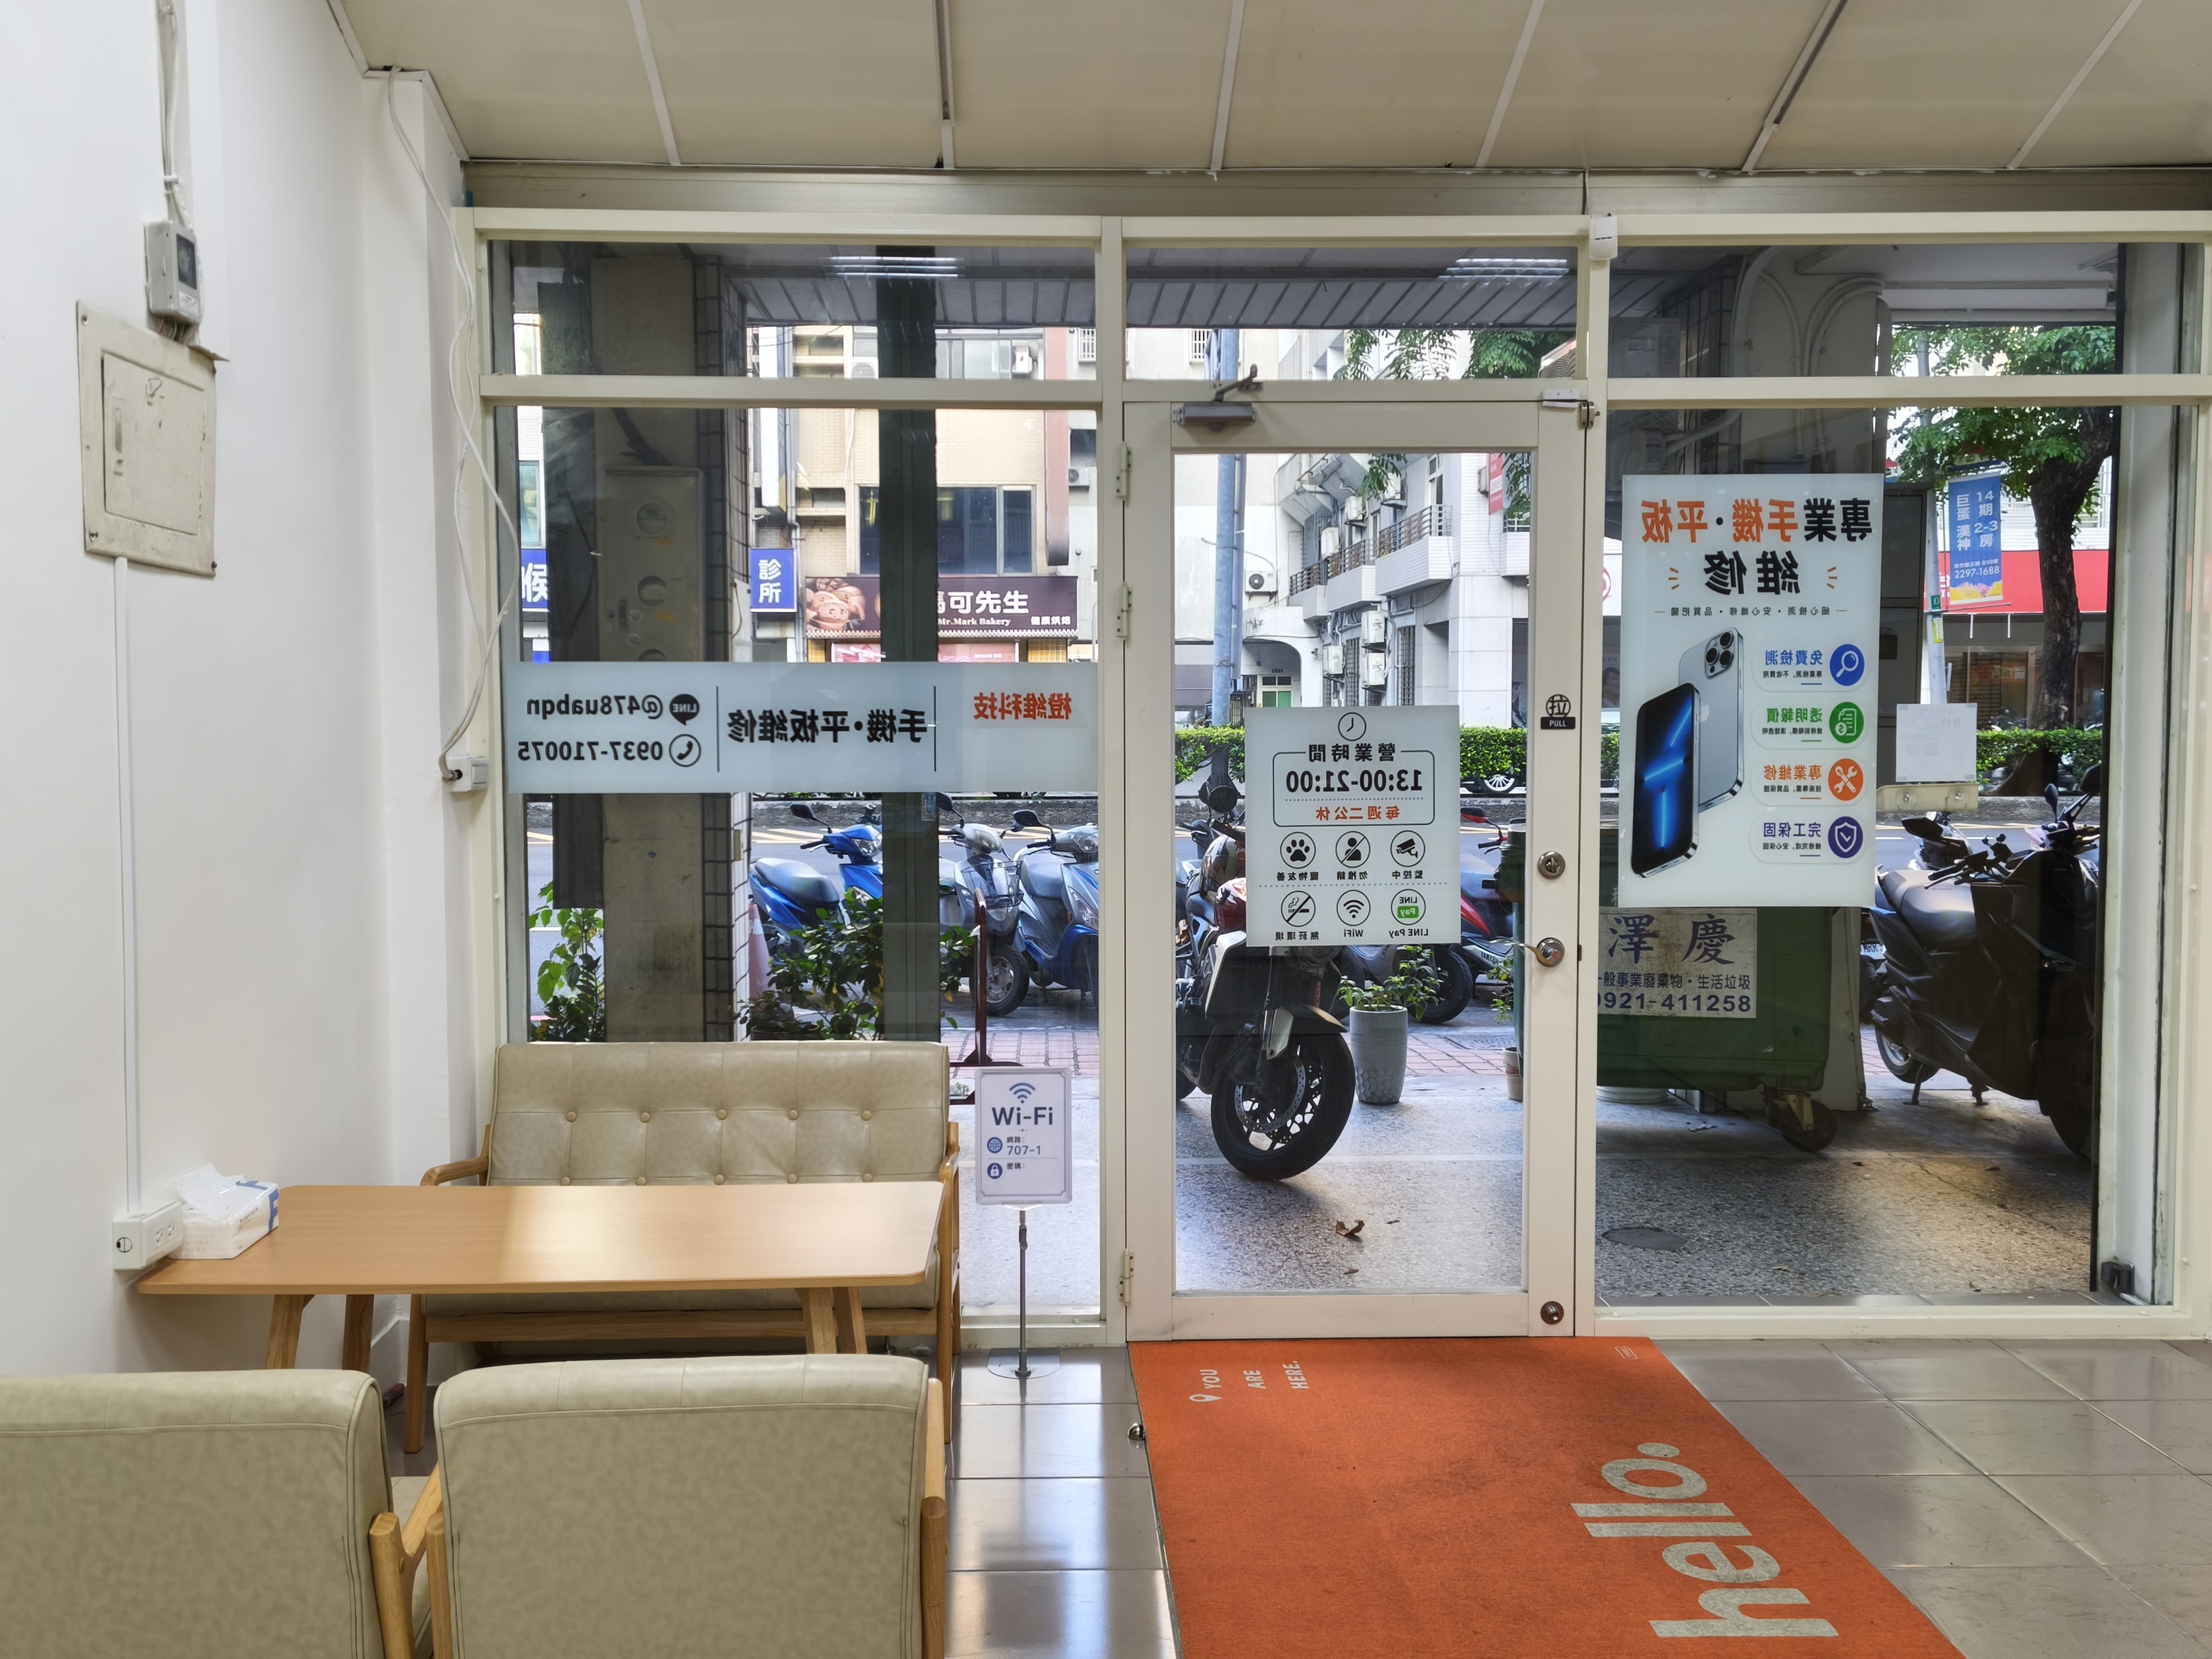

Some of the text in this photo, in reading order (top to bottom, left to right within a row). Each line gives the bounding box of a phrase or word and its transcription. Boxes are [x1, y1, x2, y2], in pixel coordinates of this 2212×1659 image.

[758, 558, 782, 604] 診所
[1954, 565, 2000, 579] 2297-1688
[979, 617, 1011, 626] Bakery
[1597, 972, 1751, 990] 般事業廢棄物·生活垃圾
[1598, 992, 1752, 1011] 921-411258
[992, 1107, 1053, 1125] Wi-Fi
[1007, 1145, 1041, 1155] 707-1
[1201, 1370, 1221, 1388] YOU
[1244, 1371, 1266, 1388] ARE
